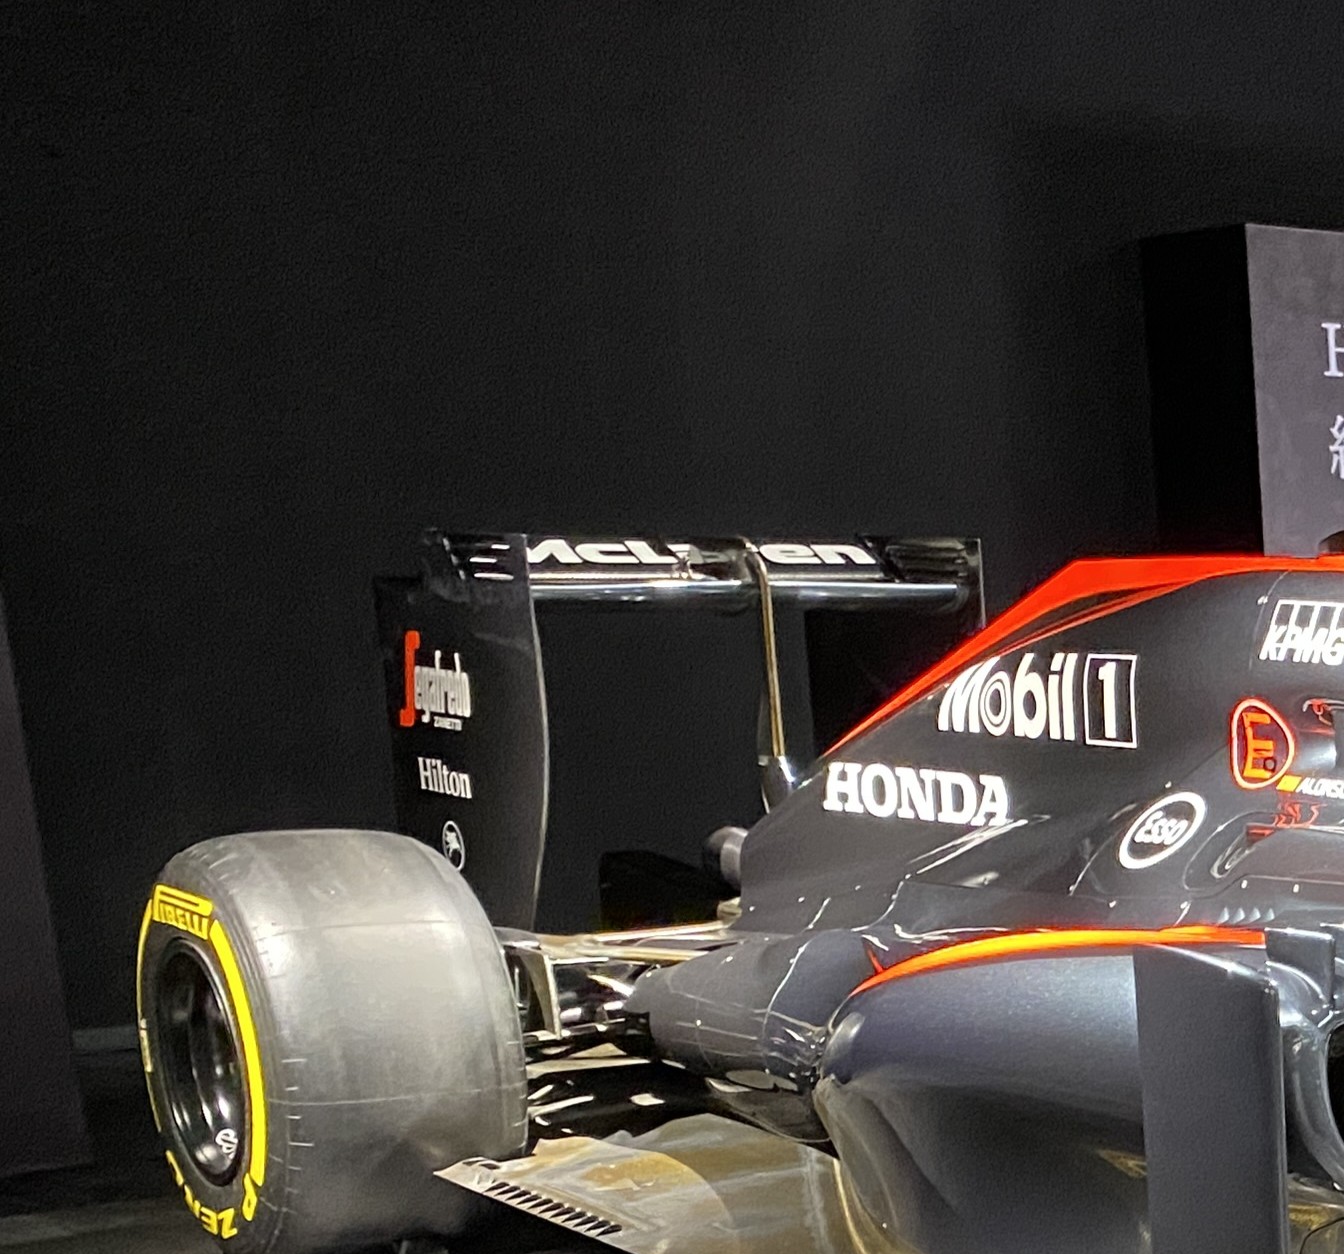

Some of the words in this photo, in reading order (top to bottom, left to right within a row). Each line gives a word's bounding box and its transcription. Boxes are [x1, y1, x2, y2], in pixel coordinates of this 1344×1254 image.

[937, 653, 1078, 742] Mobil
[417, 757, 472, 800] Hilton
[821, 761, 1012, 827] HONDA
[152, 884, 214, 941] PIRELLI
